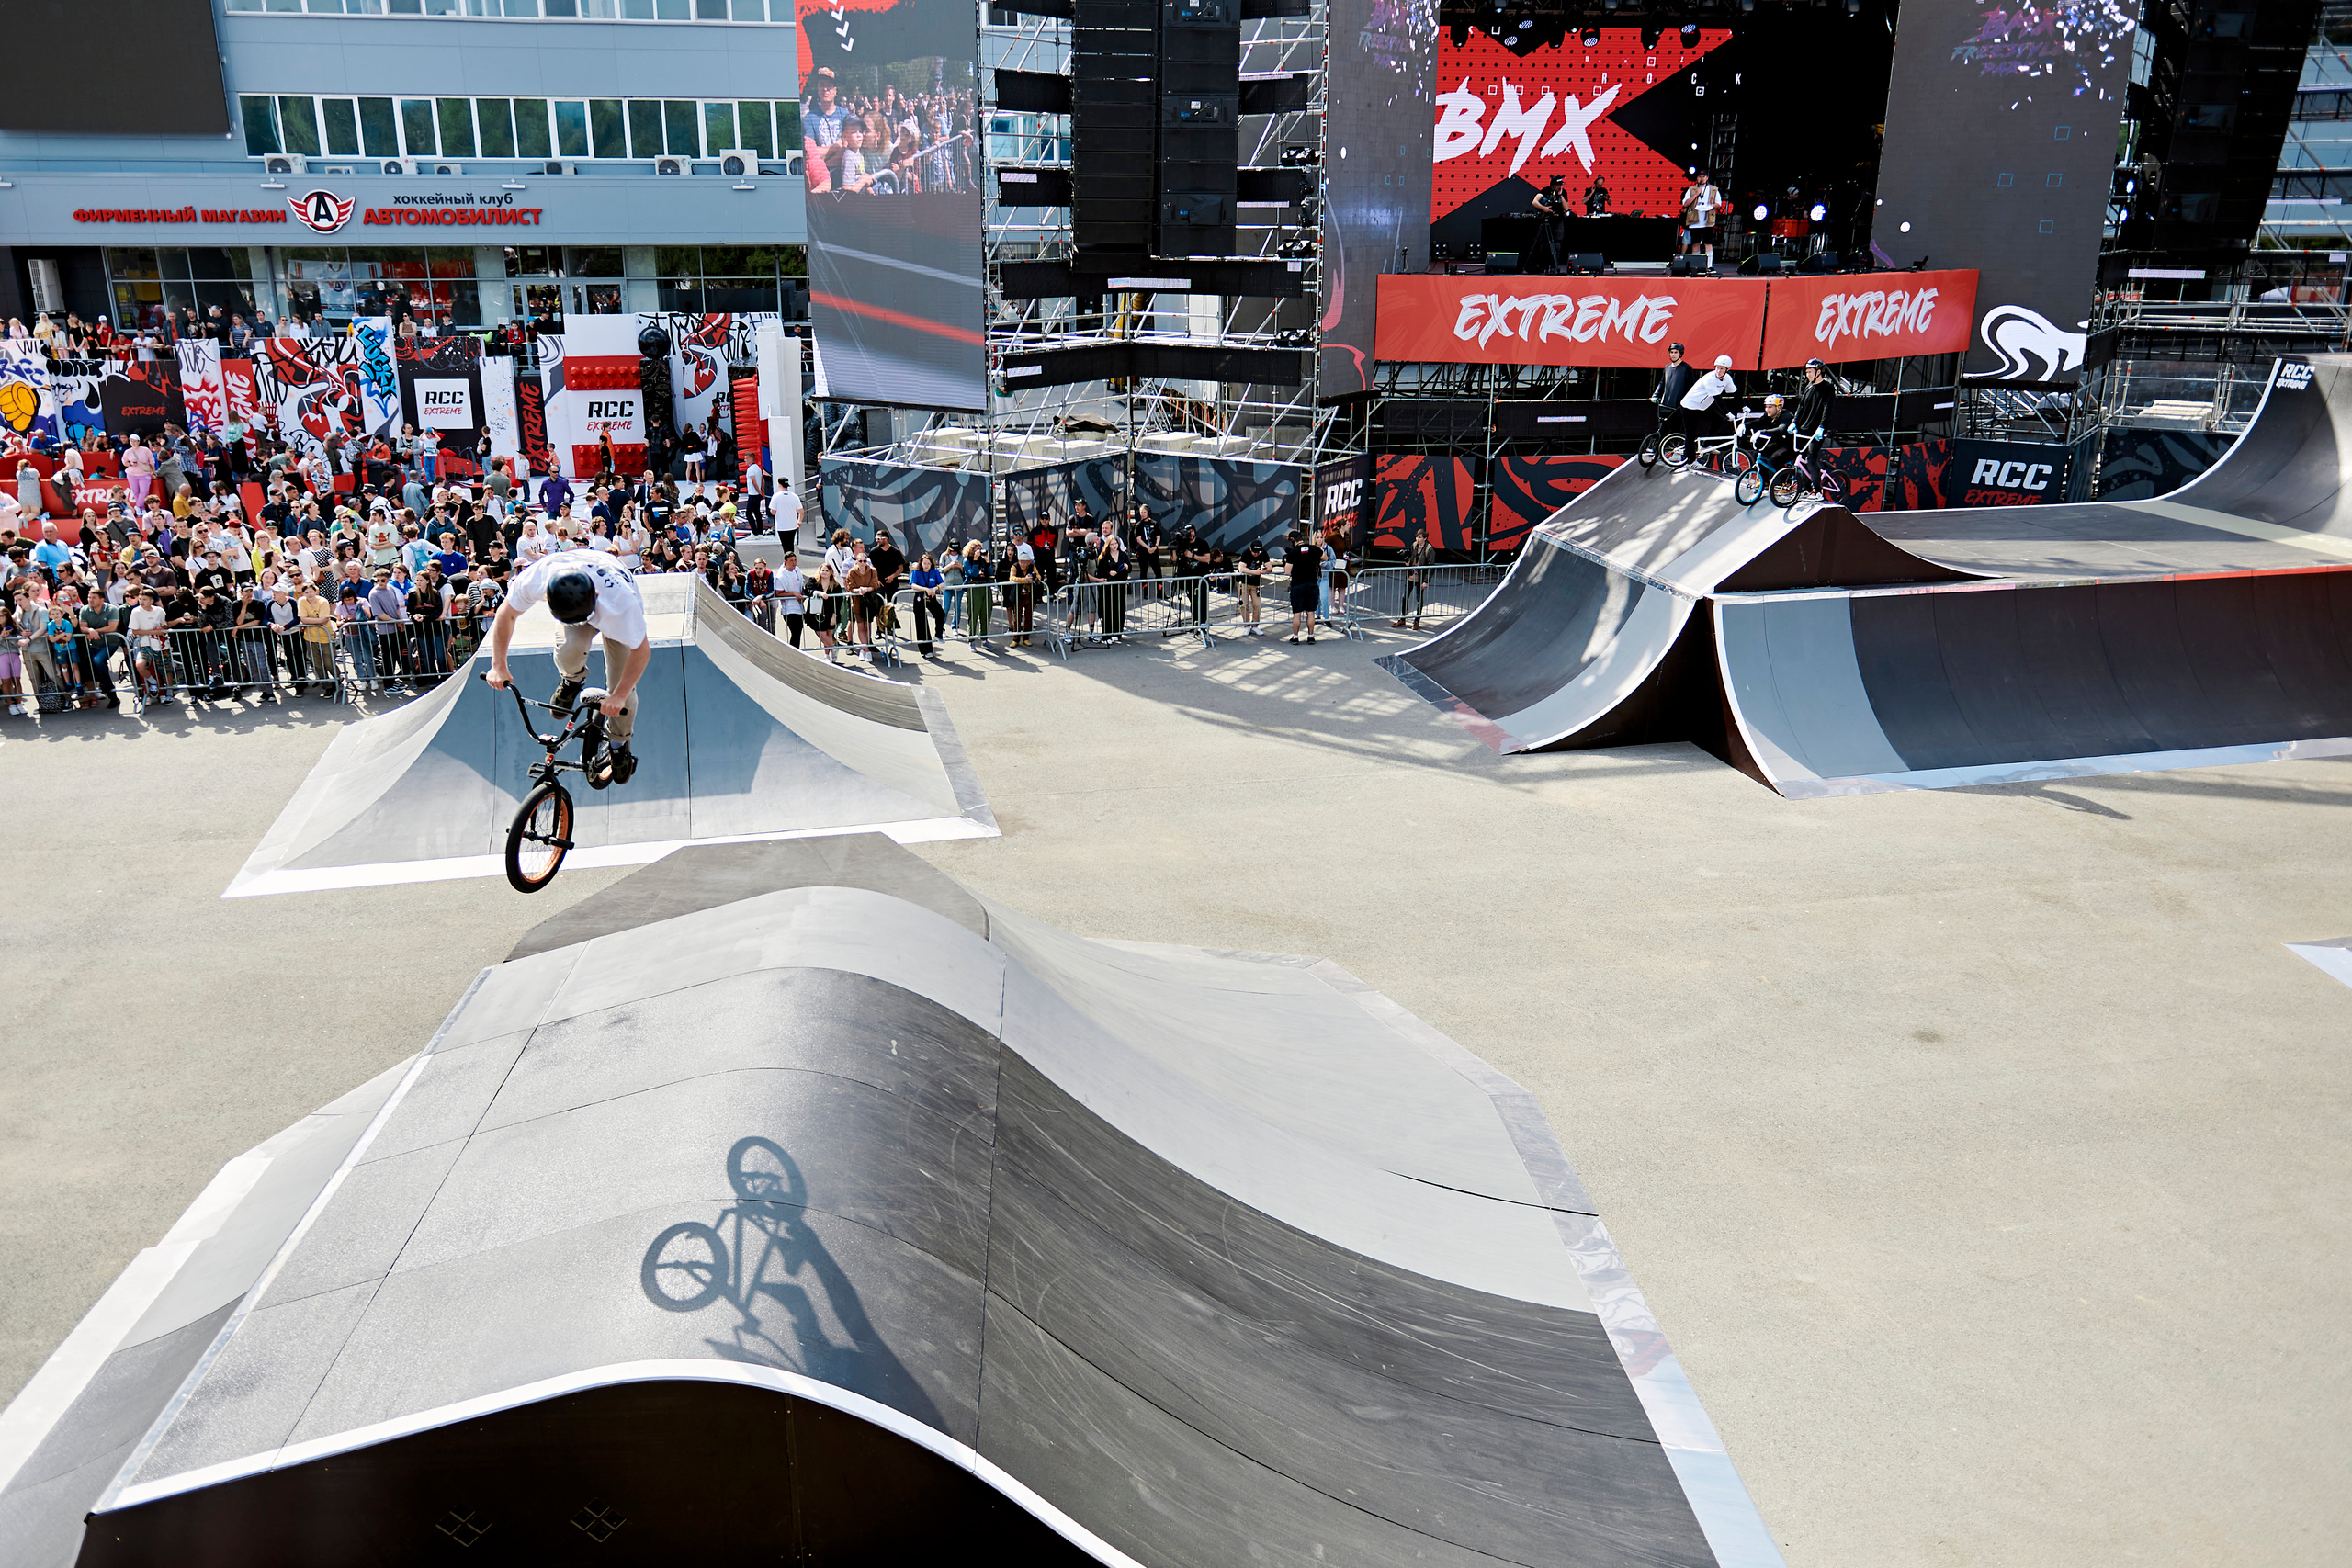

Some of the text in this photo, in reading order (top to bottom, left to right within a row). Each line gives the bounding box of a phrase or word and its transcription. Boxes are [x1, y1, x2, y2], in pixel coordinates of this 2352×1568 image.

[1433, 76, 1623, 178] BMX
[393, 193, 513, 207] хоккейный клуб
[73, 206, 287, 223] ФИРМЕННЫЙ МАГАЗИН
[363, 208, 542, 225] АВТОМОБИЛИСТ
[1453, 293, 1678, 351] EXTREME
[1815, 287, 1939, 351] EXTREME
[2280, 363, 2315, 380] RCC
[424, 391, 464, 405] RCC
[121, 406, 166, 416] EXTREME
[424, 407, 463, 416] EXTREME
[588, 400, 634, 418] RCC
[519, 381, 548, 472] EXTREME
[1971, 458, 2053, 491] RCC
[1324, 479, 1363, 515] RCC
[1964, 489, 2042, 506] EXTREME
